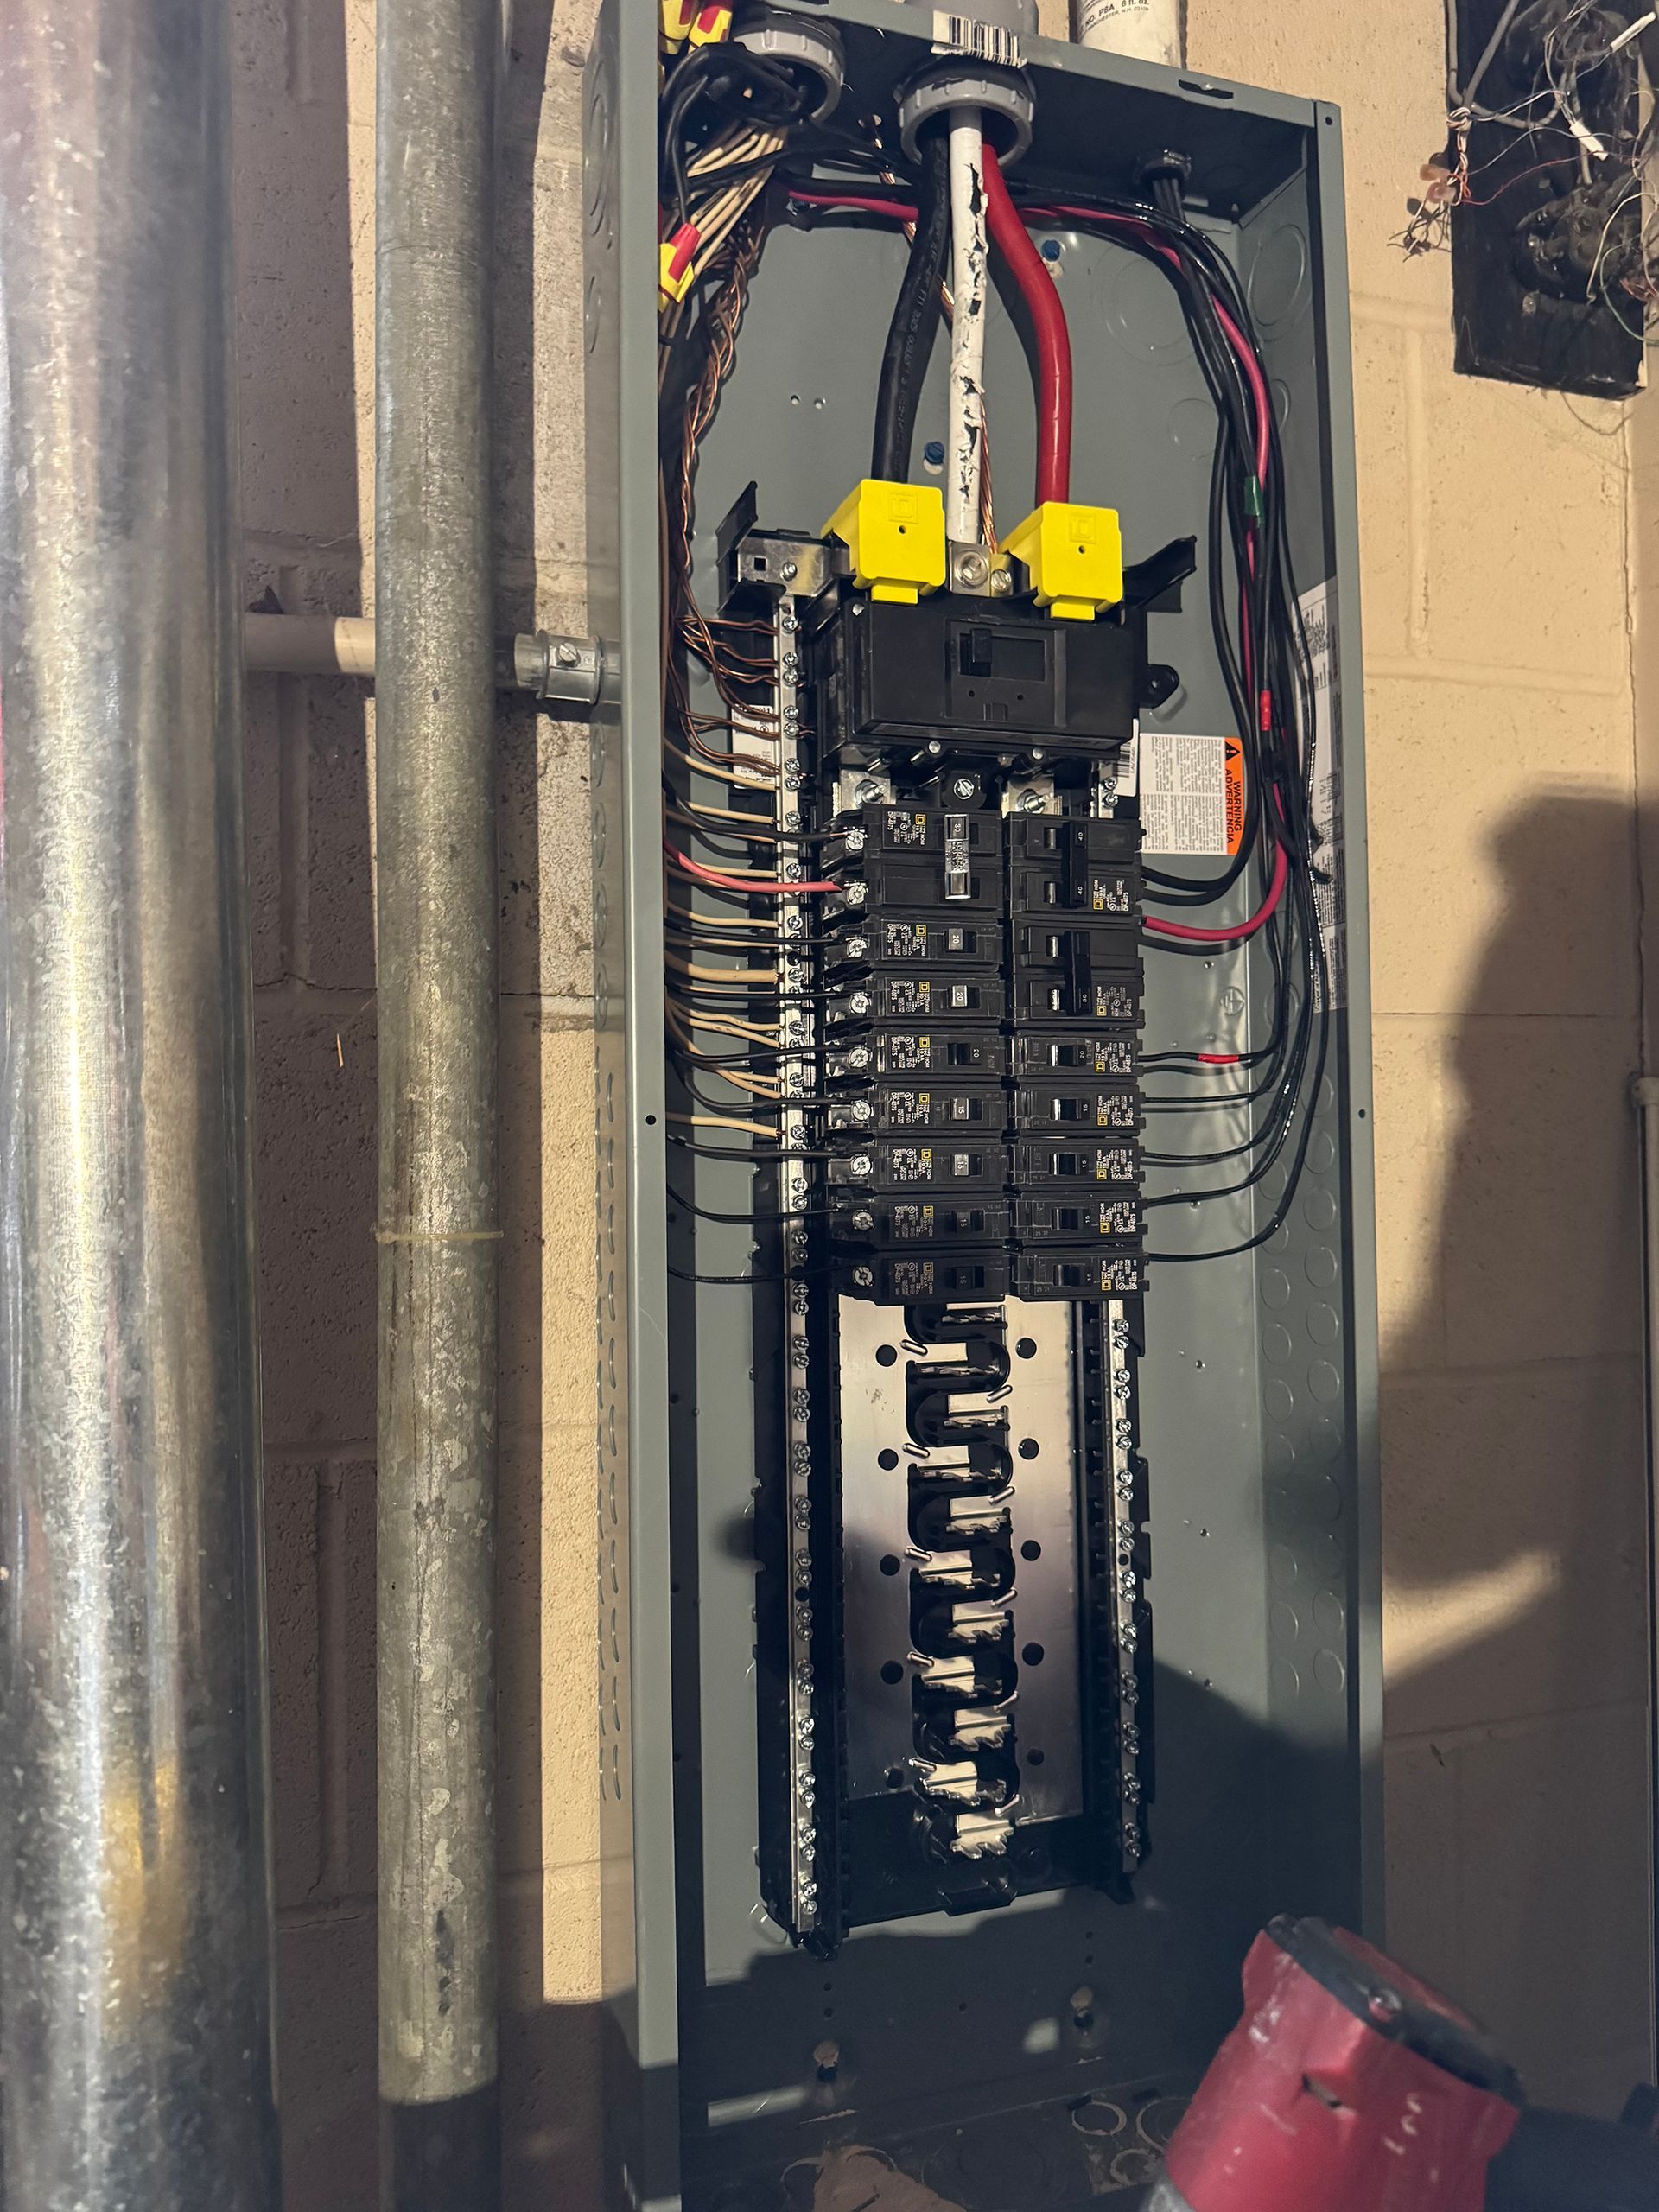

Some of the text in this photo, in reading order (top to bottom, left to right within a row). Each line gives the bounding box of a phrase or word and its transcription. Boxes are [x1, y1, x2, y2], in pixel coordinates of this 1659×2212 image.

[1225, 769, 1234, 843] ADVERTENCIA
[1234, 781, 1243, 831] WARNING
[954, 823, 961, 833] 30
[1078, 832, 1083, 841] 40
[1078, 887, 1083, 895] 40
[953, 935, 959, 944] 20
[957, 992, 963, 1001] 20
[974, 1049, 980, 1058] 20
